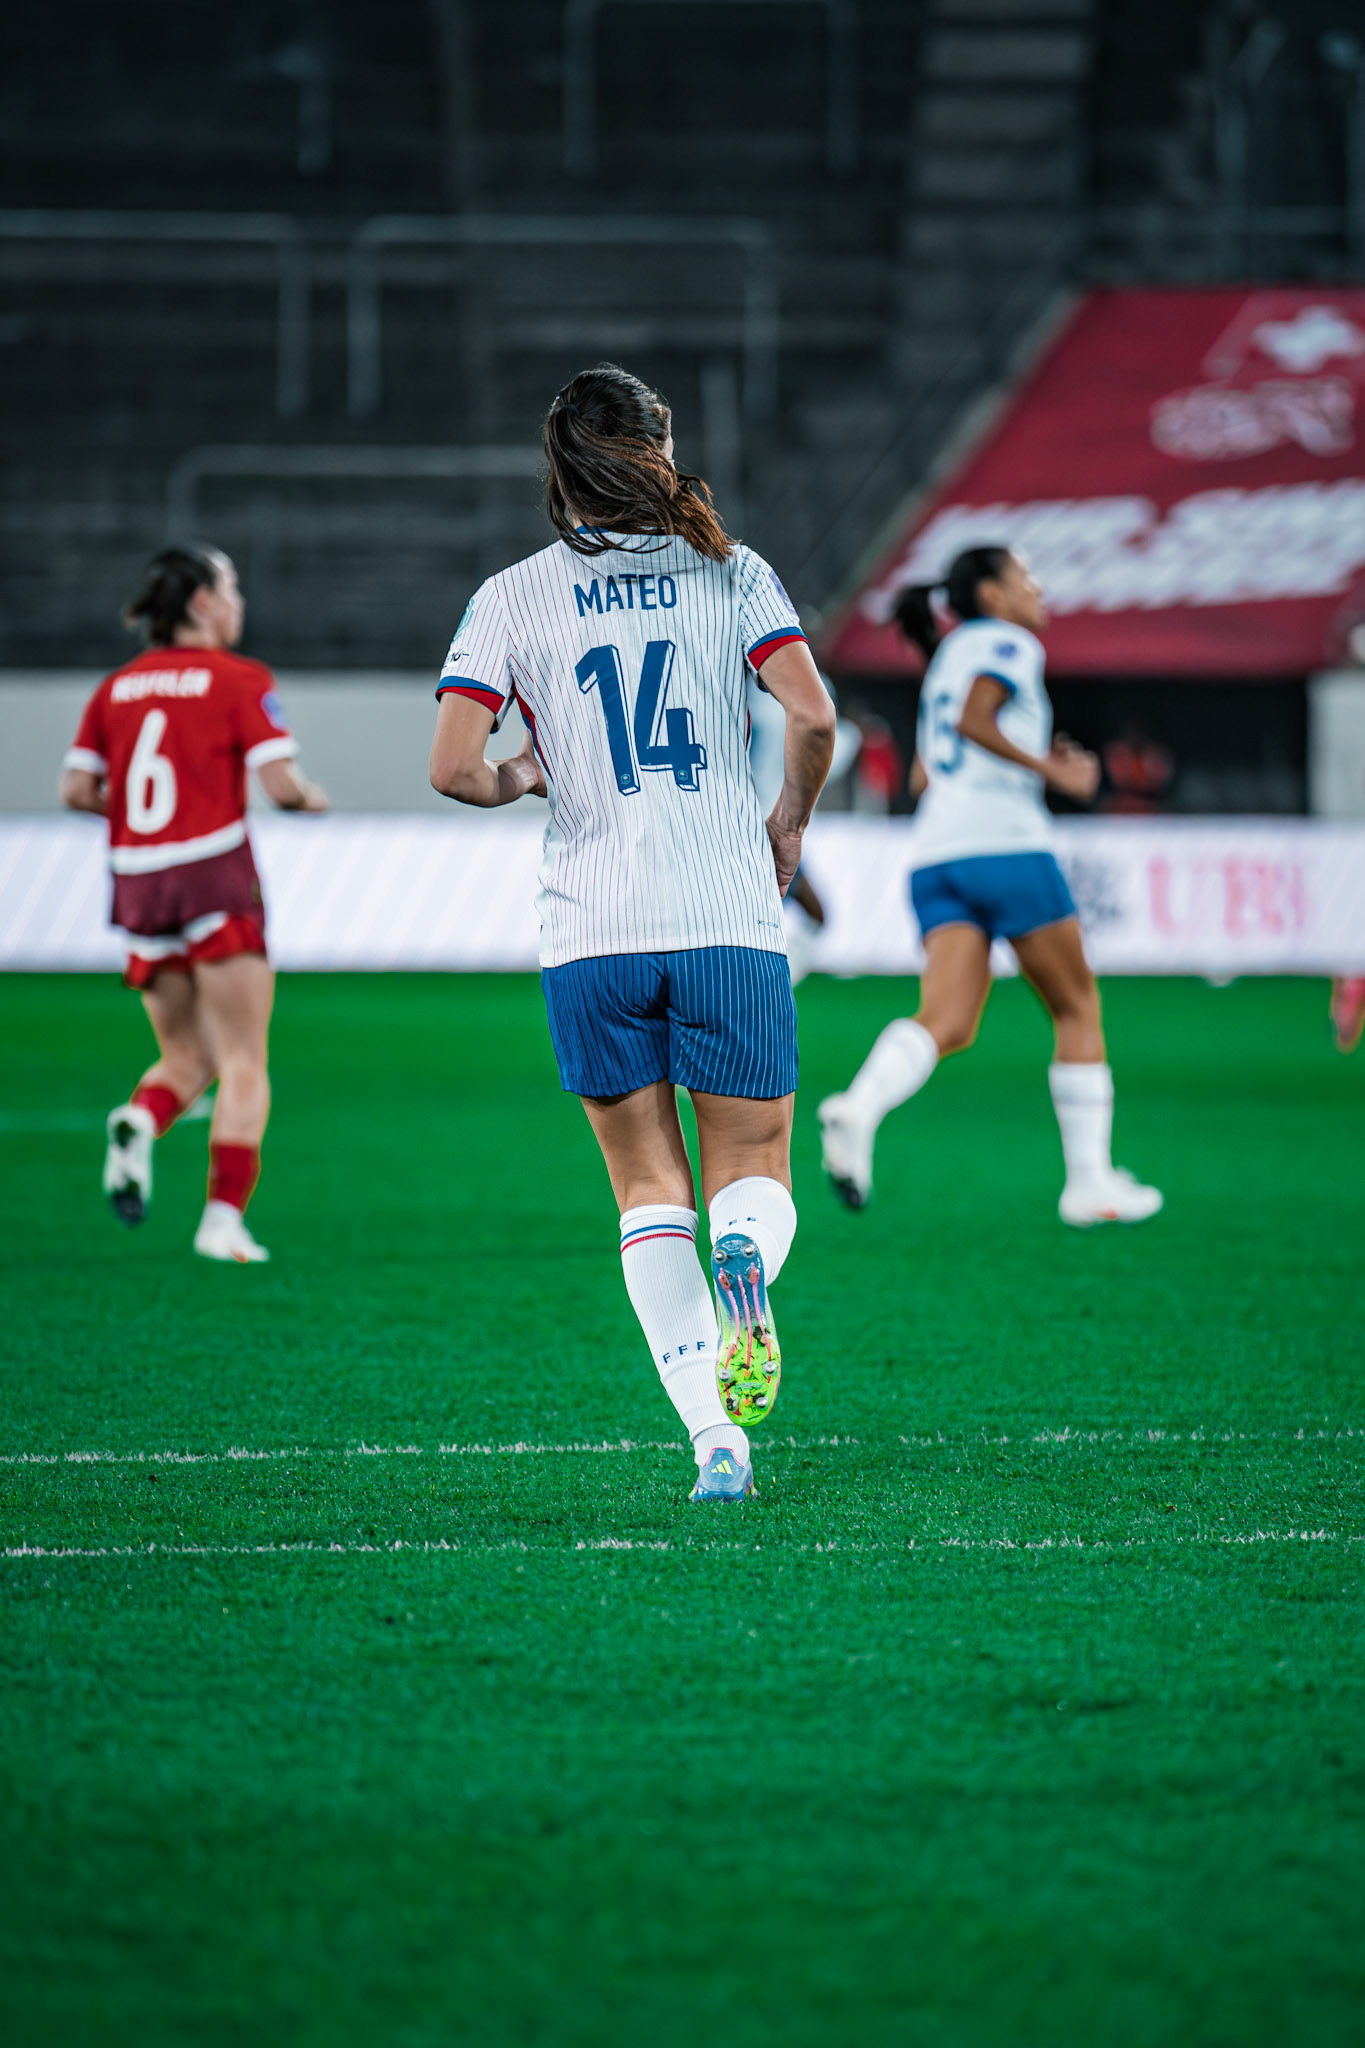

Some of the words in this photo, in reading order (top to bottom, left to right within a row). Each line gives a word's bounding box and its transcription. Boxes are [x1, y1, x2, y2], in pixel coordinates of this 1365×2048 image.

[573, 573, 677, 617] MATEO
[126, 708, 177, 834] 6
[575, 640, 708, 796] 14
